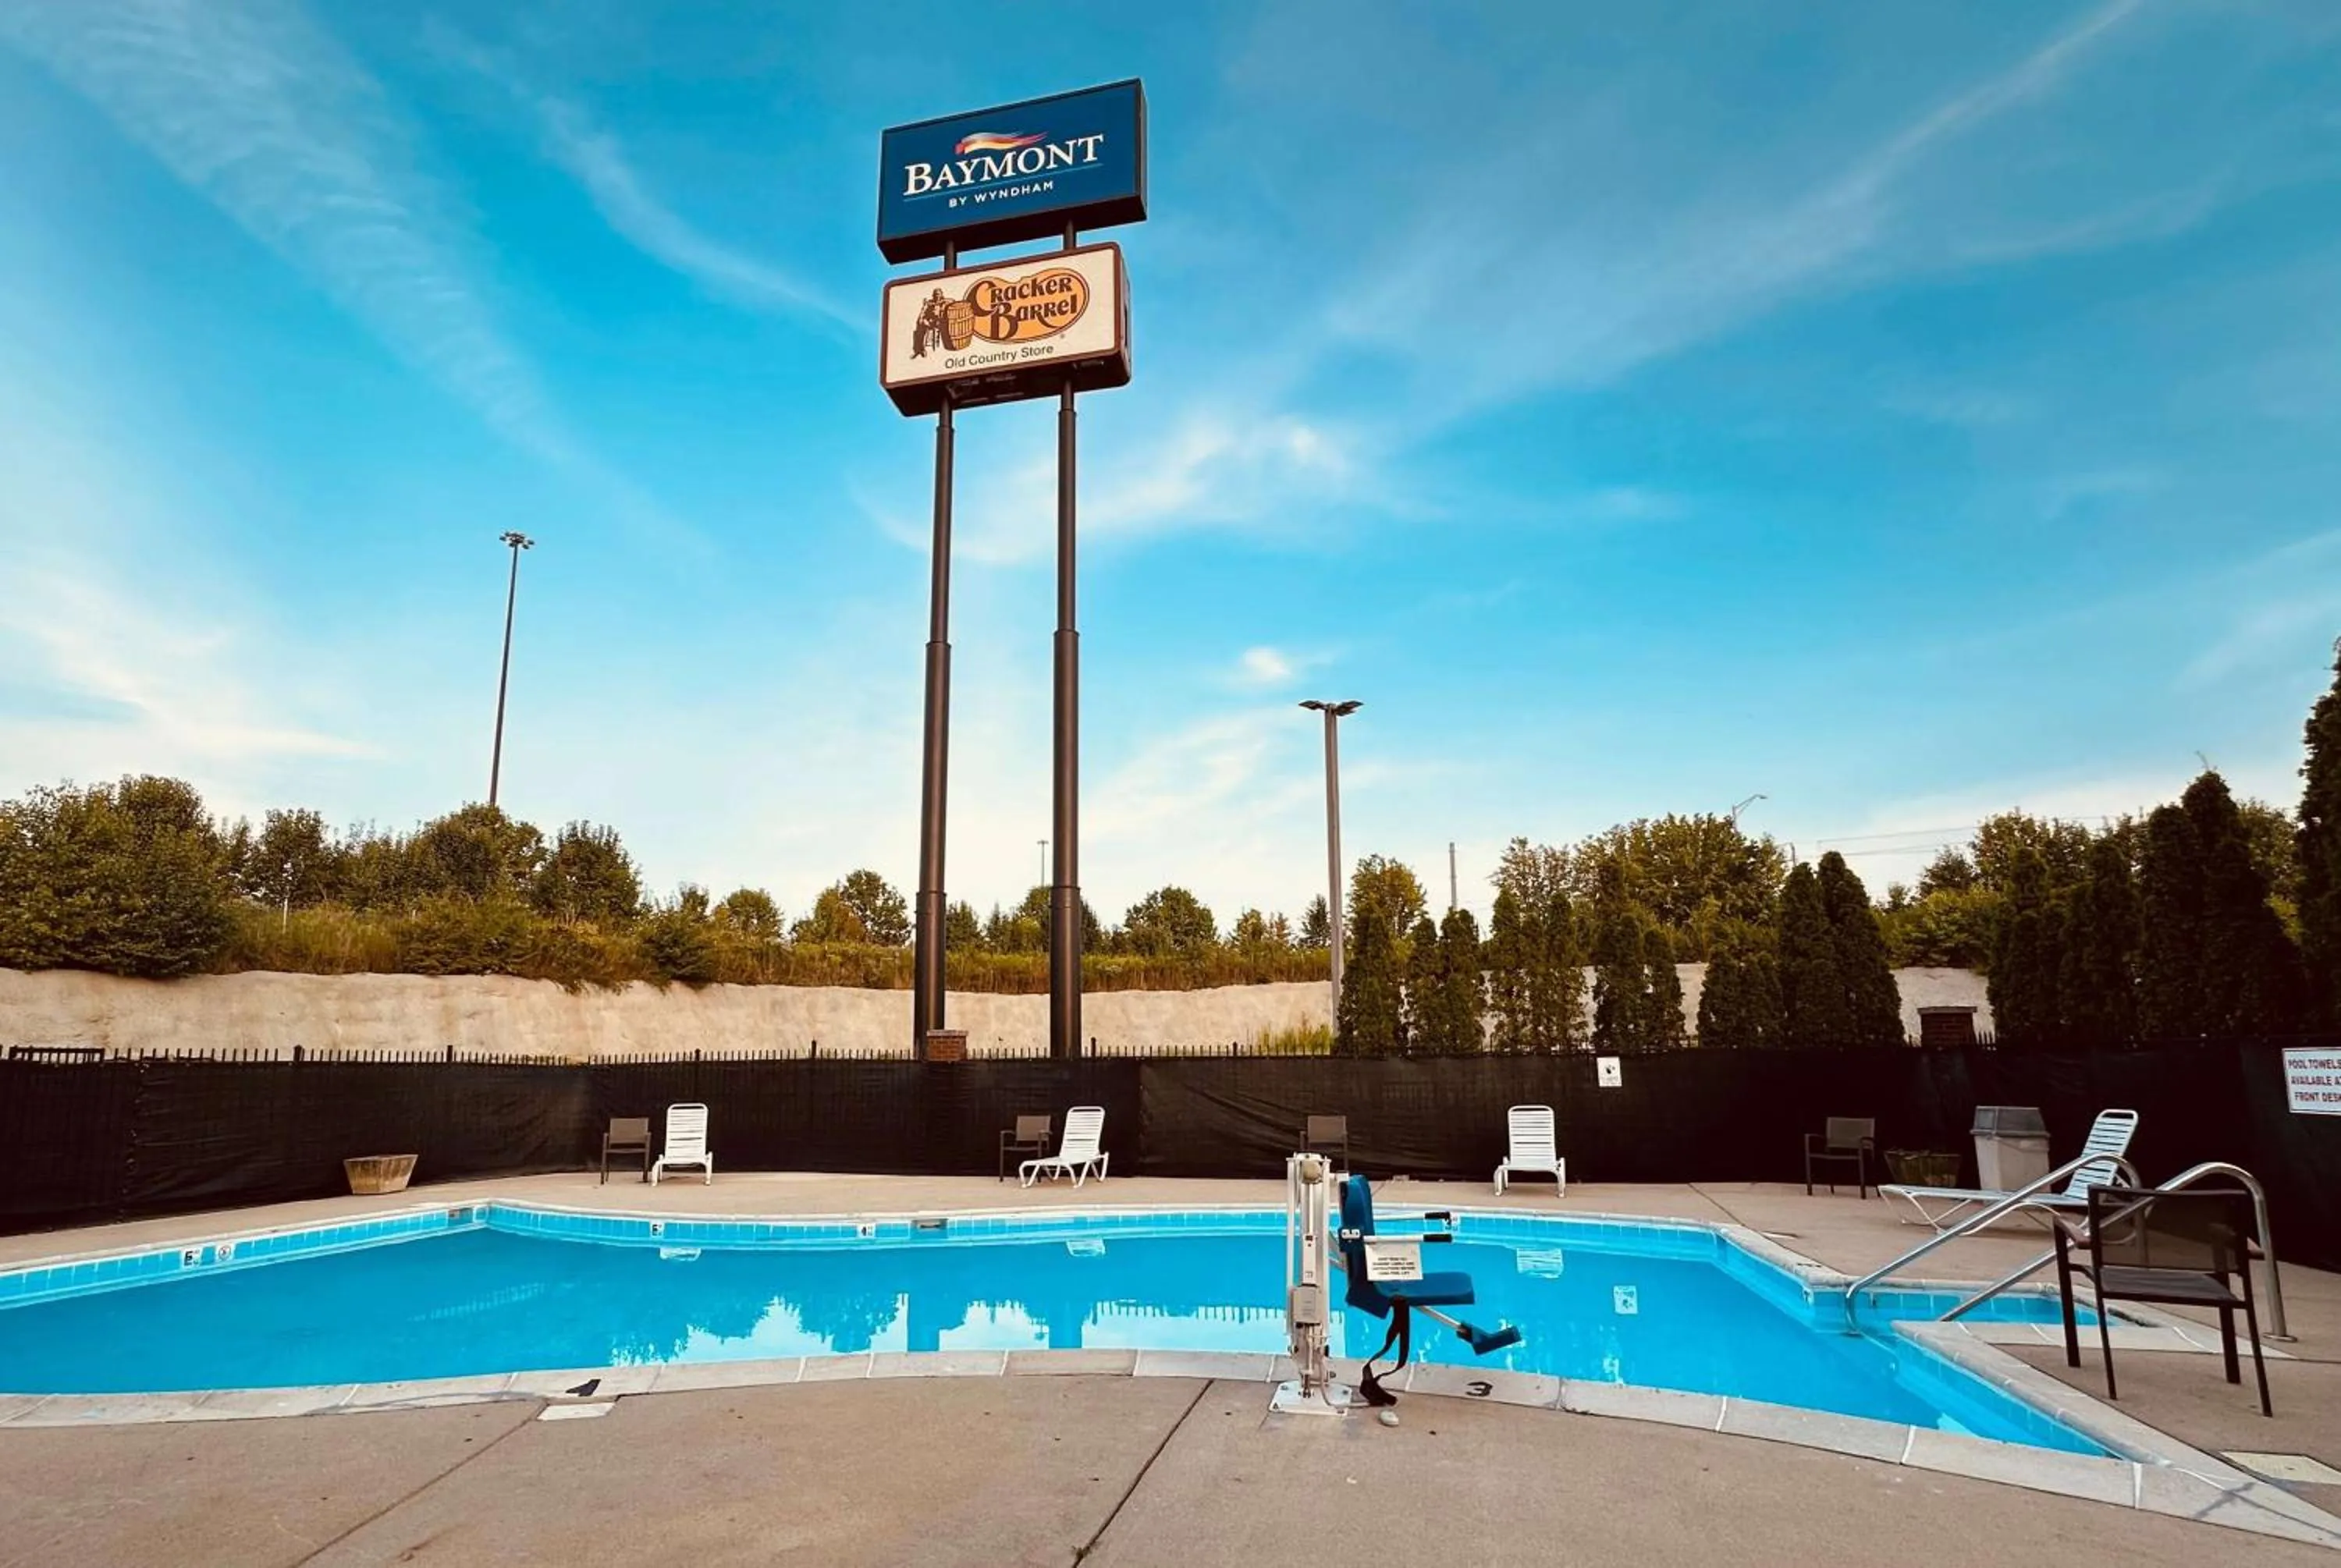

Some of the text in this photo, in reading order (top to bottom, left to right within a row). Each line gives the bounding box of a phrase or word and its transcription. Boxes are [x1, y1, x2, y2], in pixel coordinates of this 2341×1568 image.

[903, 133, 1104, 196] BAYMONT
[948, 181, 1053, 208] BY WYNDHAM
[966, 276, 1073, 317] Cracker
[989, 293, 1078, 340] Barrel
[945, 345, 1054, 369] Old Country Store
[2288, 1059, 2307, 1069] POOL
[2291, 1076, 2332, 1085] AVAILABLE
[2295, 1092, 2319, 1102] FRONT
[1465, 1382, 1493, 1397] 3
